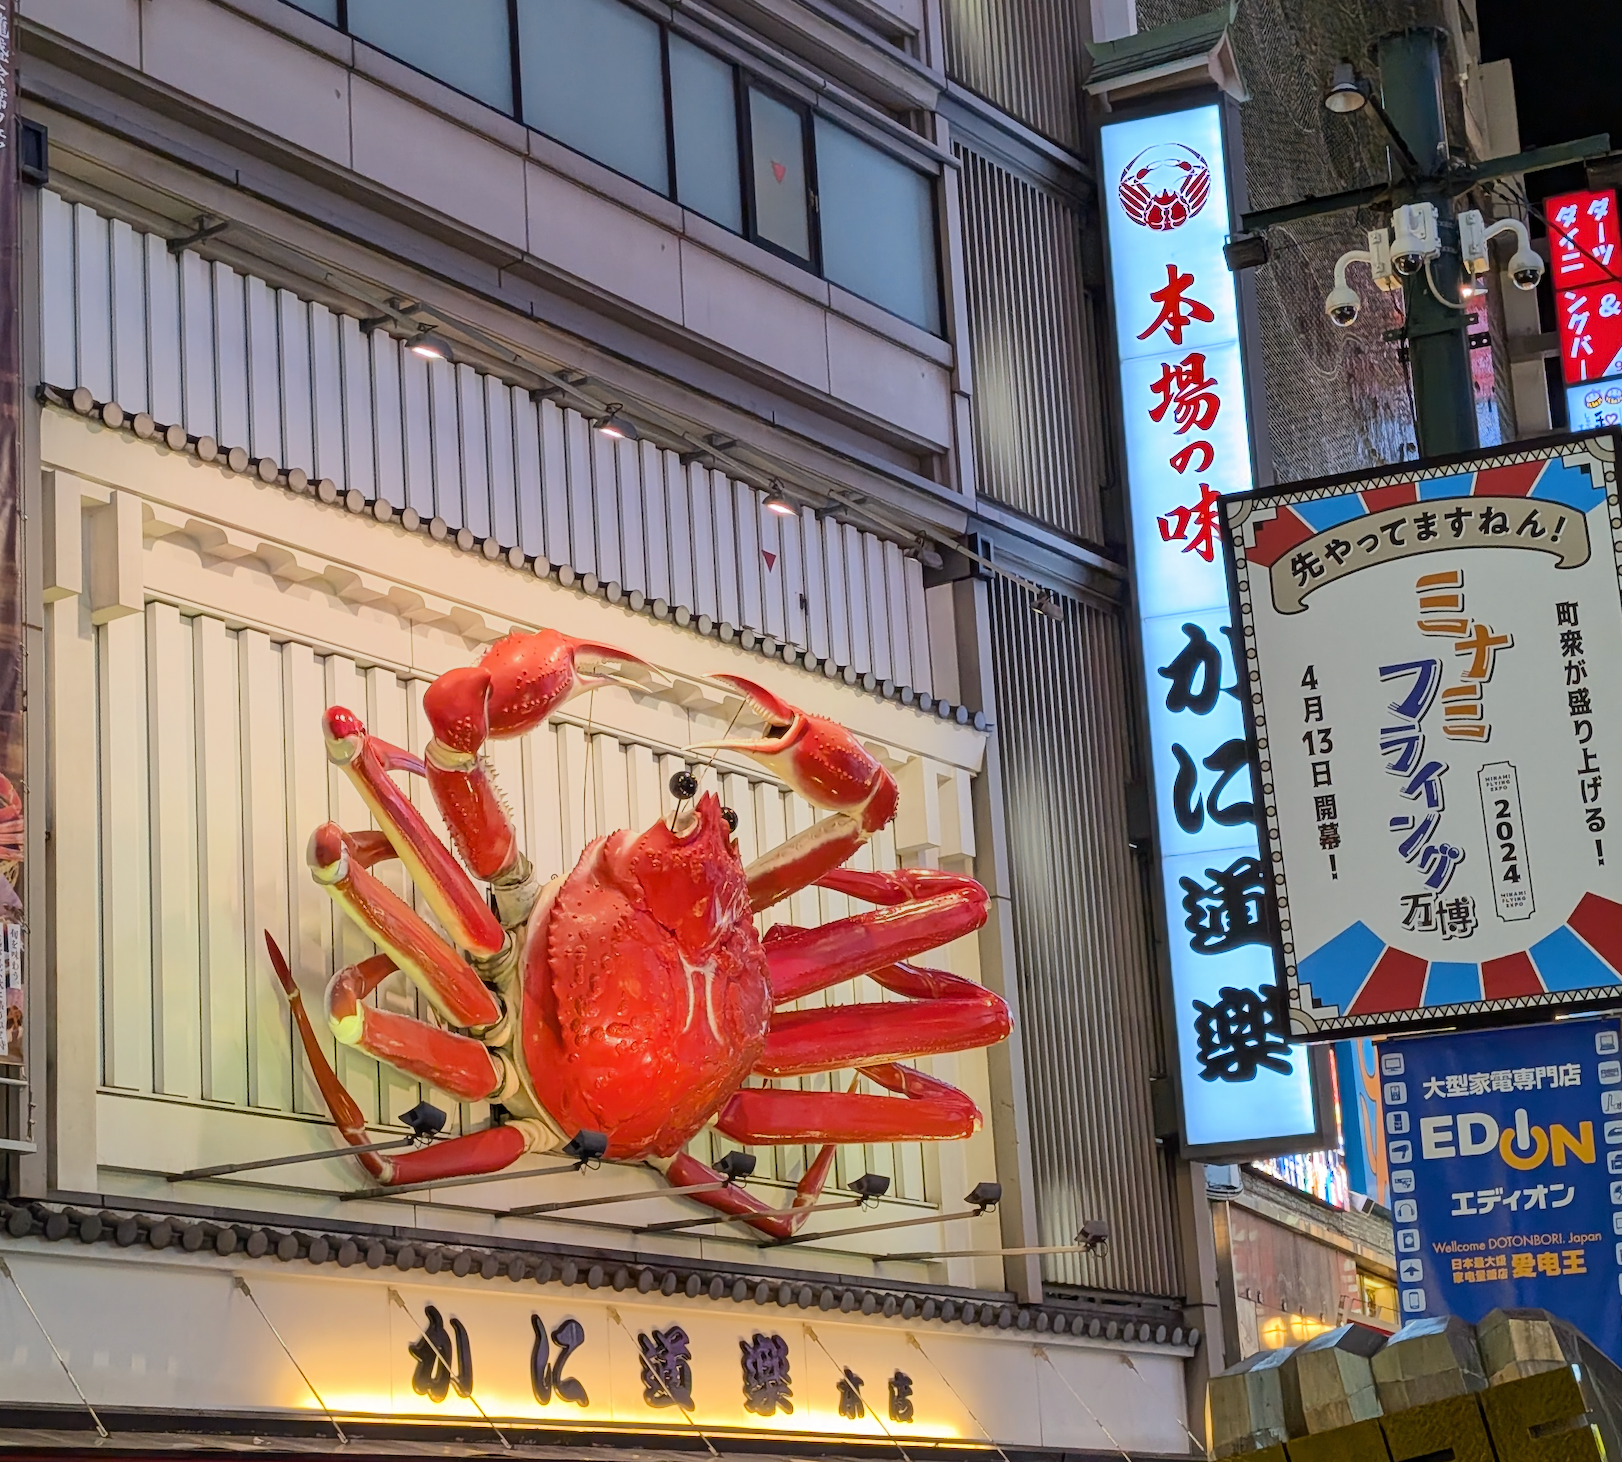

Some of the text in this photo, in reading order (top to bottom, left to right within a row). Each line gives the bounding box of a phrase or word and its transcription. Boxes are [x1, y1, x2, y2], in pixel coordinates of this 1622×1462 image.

[1136, 264, 1221, 562] 本場の味
[1290, 507, 1566, 587] 先やってますねん!
[1415, 570, 1514, 742] ミナミ
[1555, 601, 1605, 866] 町衆が盛り上げる!
[1379, 658, 1478, 940] フライング 万博
[1494, 799, 1521, 884] 2024
[1423, 1063, 1581, 1100] 大型家電専門店
[1420, 1108, 1596, 1170] EDION
[1451, 1183, 1575, 1216] エディオン
[1568, 1232, 1602, 1245] Japan
